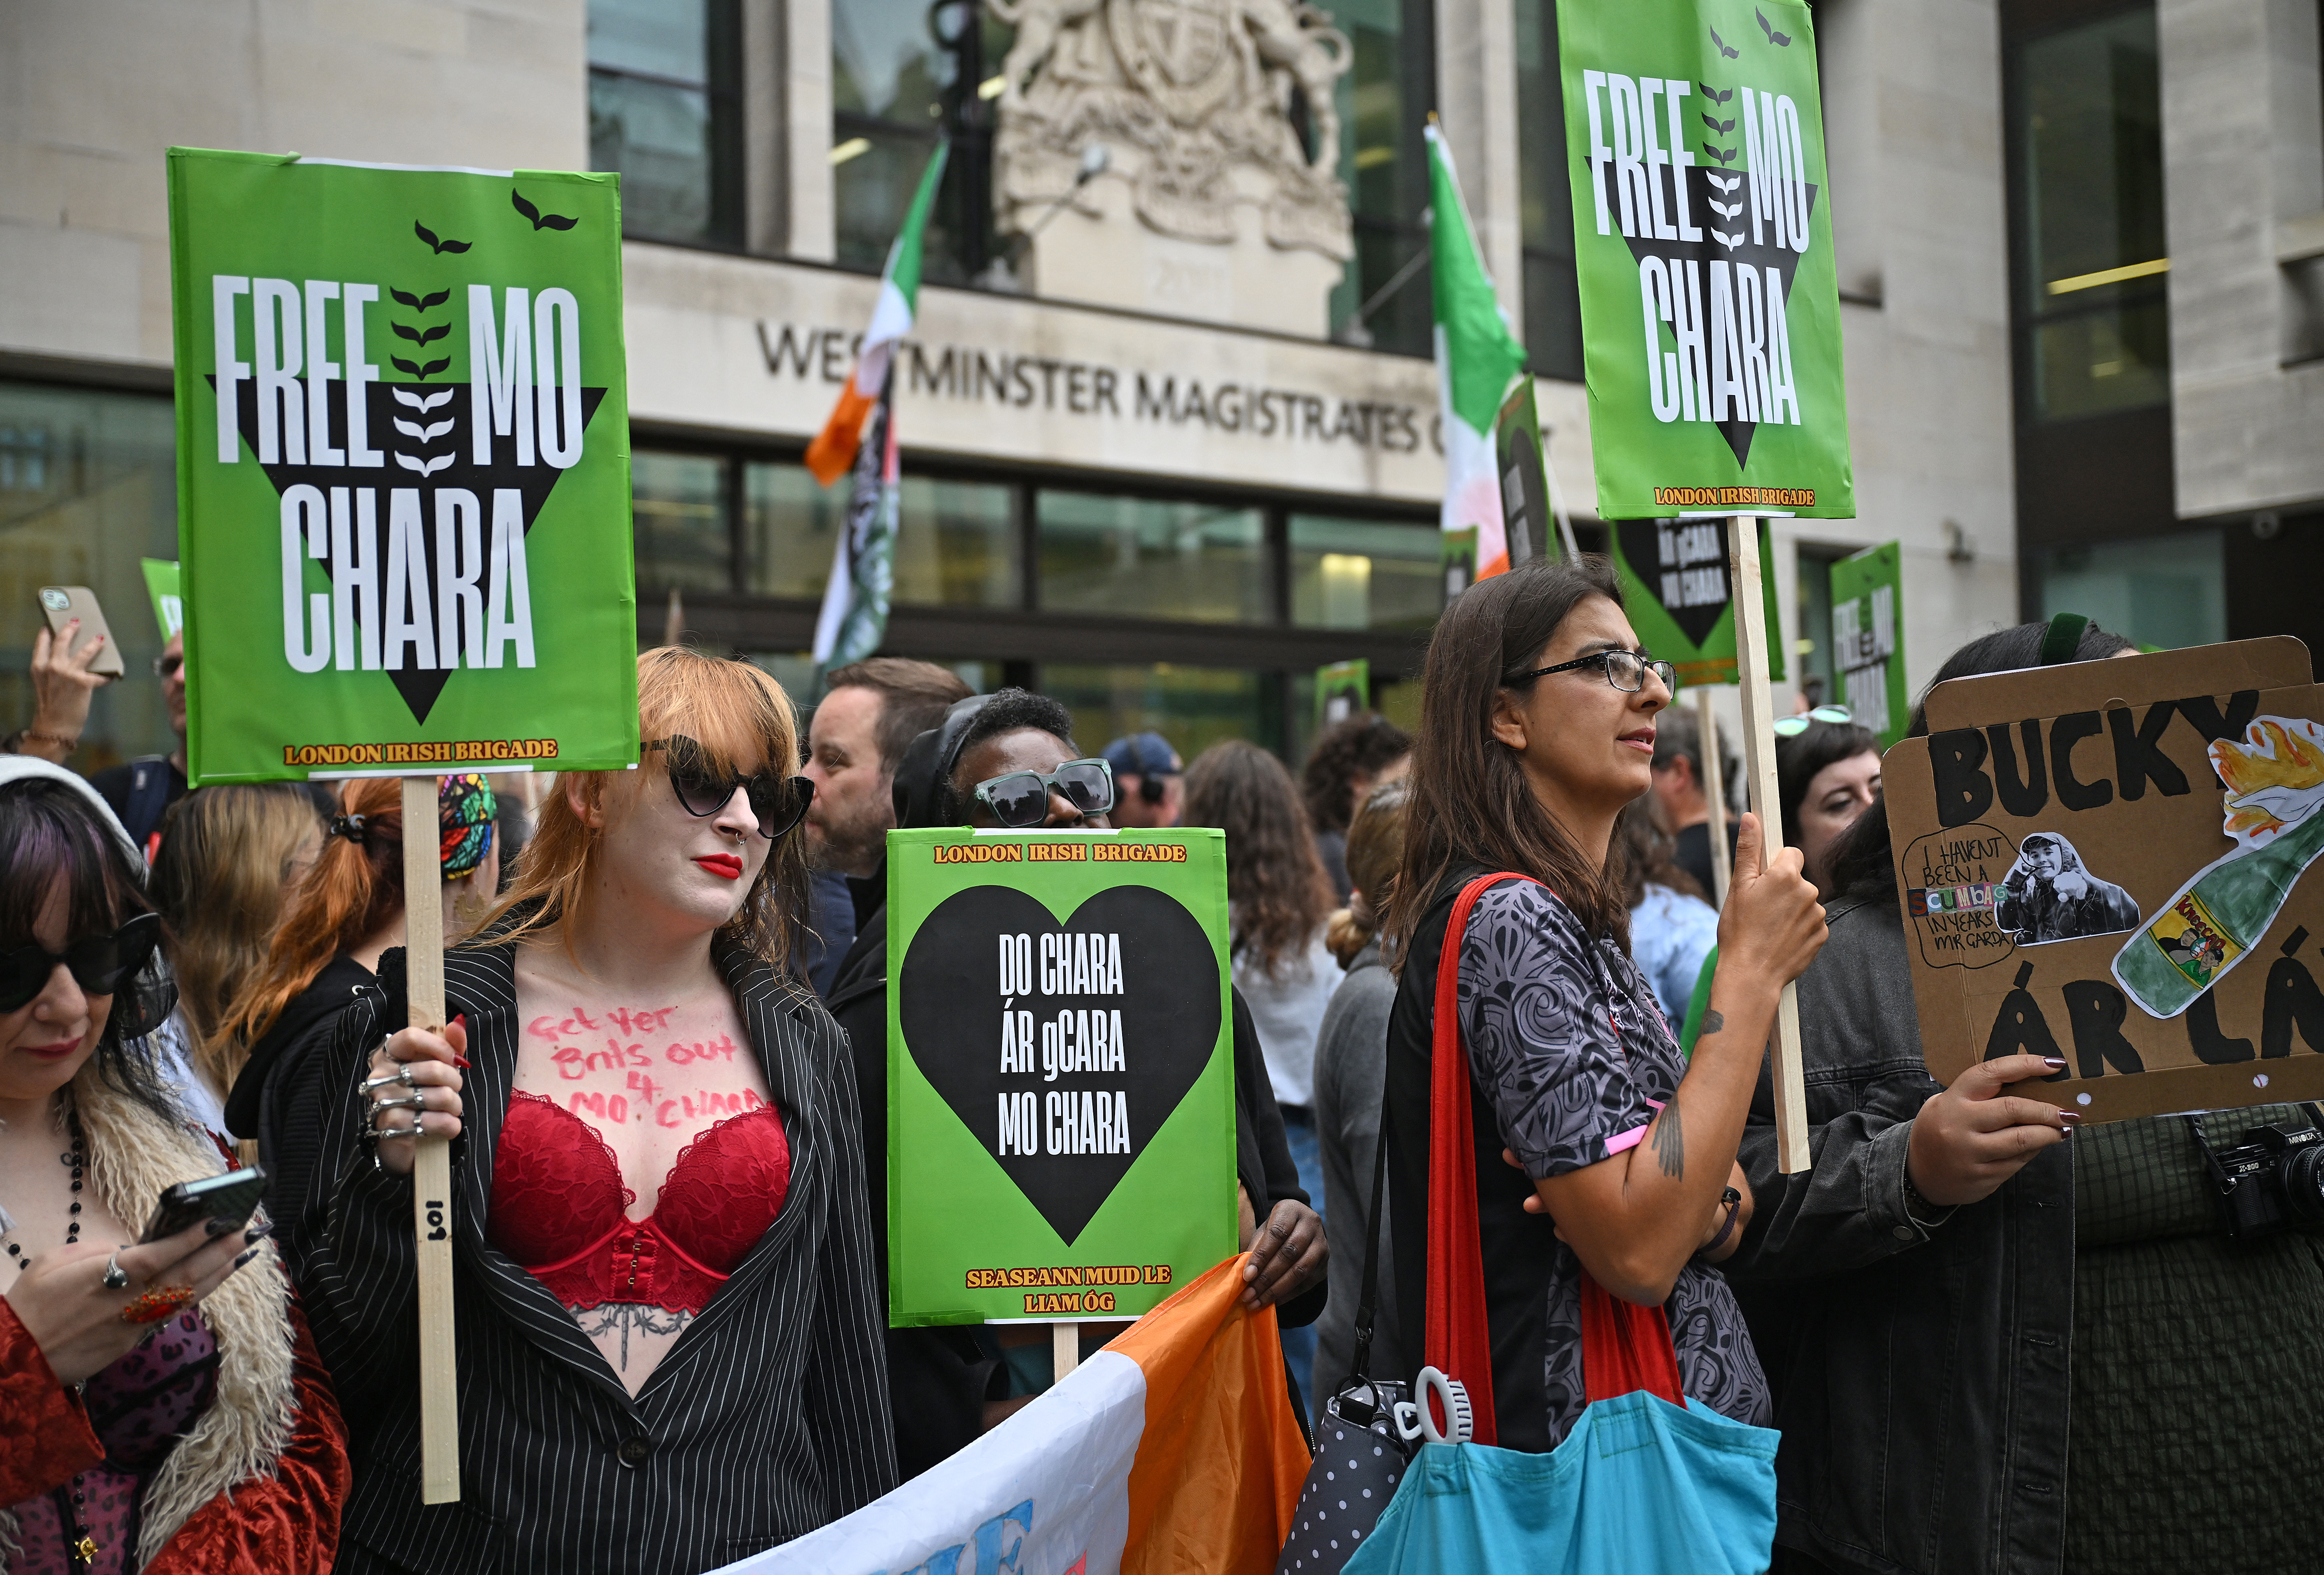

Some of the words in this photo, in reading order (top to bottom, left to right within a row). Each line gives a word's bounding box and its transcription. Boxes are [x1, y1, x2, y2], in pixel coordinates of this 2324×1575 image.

[1583, 69, 1703, 242] FREE
[1741, 86, 1809, 253] MO
[1639, 254, 1801, 426] CHARA
[212, 274, 384, 467] FREE
[468, 284, 583, 469] MO
[756, 320, 1121, 416] WEMINSTER
[1136, 373, 1419, 454] MAGISTRATES
[1655, 487, 1718, 505] LONDON
[1719, 486, 1760, 505] IRISH
[1761, 488, 1815, 506] BRIGADE
[280, 484, 536, 673] CHARA
[284, 745, 383, 765] LONDON
[386, 743, 452, 763] IRISH
[455, 739, 558, 761] BRIGADE
[1927, 689, 2259, 827] BUCKY
[934, 844, 1022, 863] LONDON
[1028, 843, 1088, 862] IRISH
[1093, 843, 1187, 863] BRIGADE
[1924, 845, 1929, 867] I
[1940, 837, 2002, 867] HAVENT
[1922, 864, 1972, 888] BEEN
[1978, 864, 1989, 882] A
[1926, 915, 1948, 934] IN
[1946, 910, 1994, 933] YEARS
[1934, 933, 1966, 951] MR
[1966, 931, 2010, 949] GARDA
[999, 933, 1032, 996] DO
[1040, 933, 1124, 995] CHARA
[527, 1006, 602, 1042] Get
[1000, 998, 1035, 1073] ÁR
[1043, 1009, 1126, 1082] gCARA
[1983, 960, 2146, 1086] ÁR
[665, 1032, 738, 1065] out
[626, 1070, 665, 1106] 4
[568, 1091, 628, 1124] MO
[998, 1092, 1037, 1156] MO
[1046, 1091, 1131, 1155] CHARA
[2288, 1132, 2316, 1145] MINOLTA
[966, 1266, 1083, 1289] SEASEANN
[1084, 1265, 1141, 1286] MUID
[1142, 1264, 1172, 1284] LE
[1024, 1292, 1081, 1314] LIAM
[1083, 1289, 1116, 1312] ÓG
